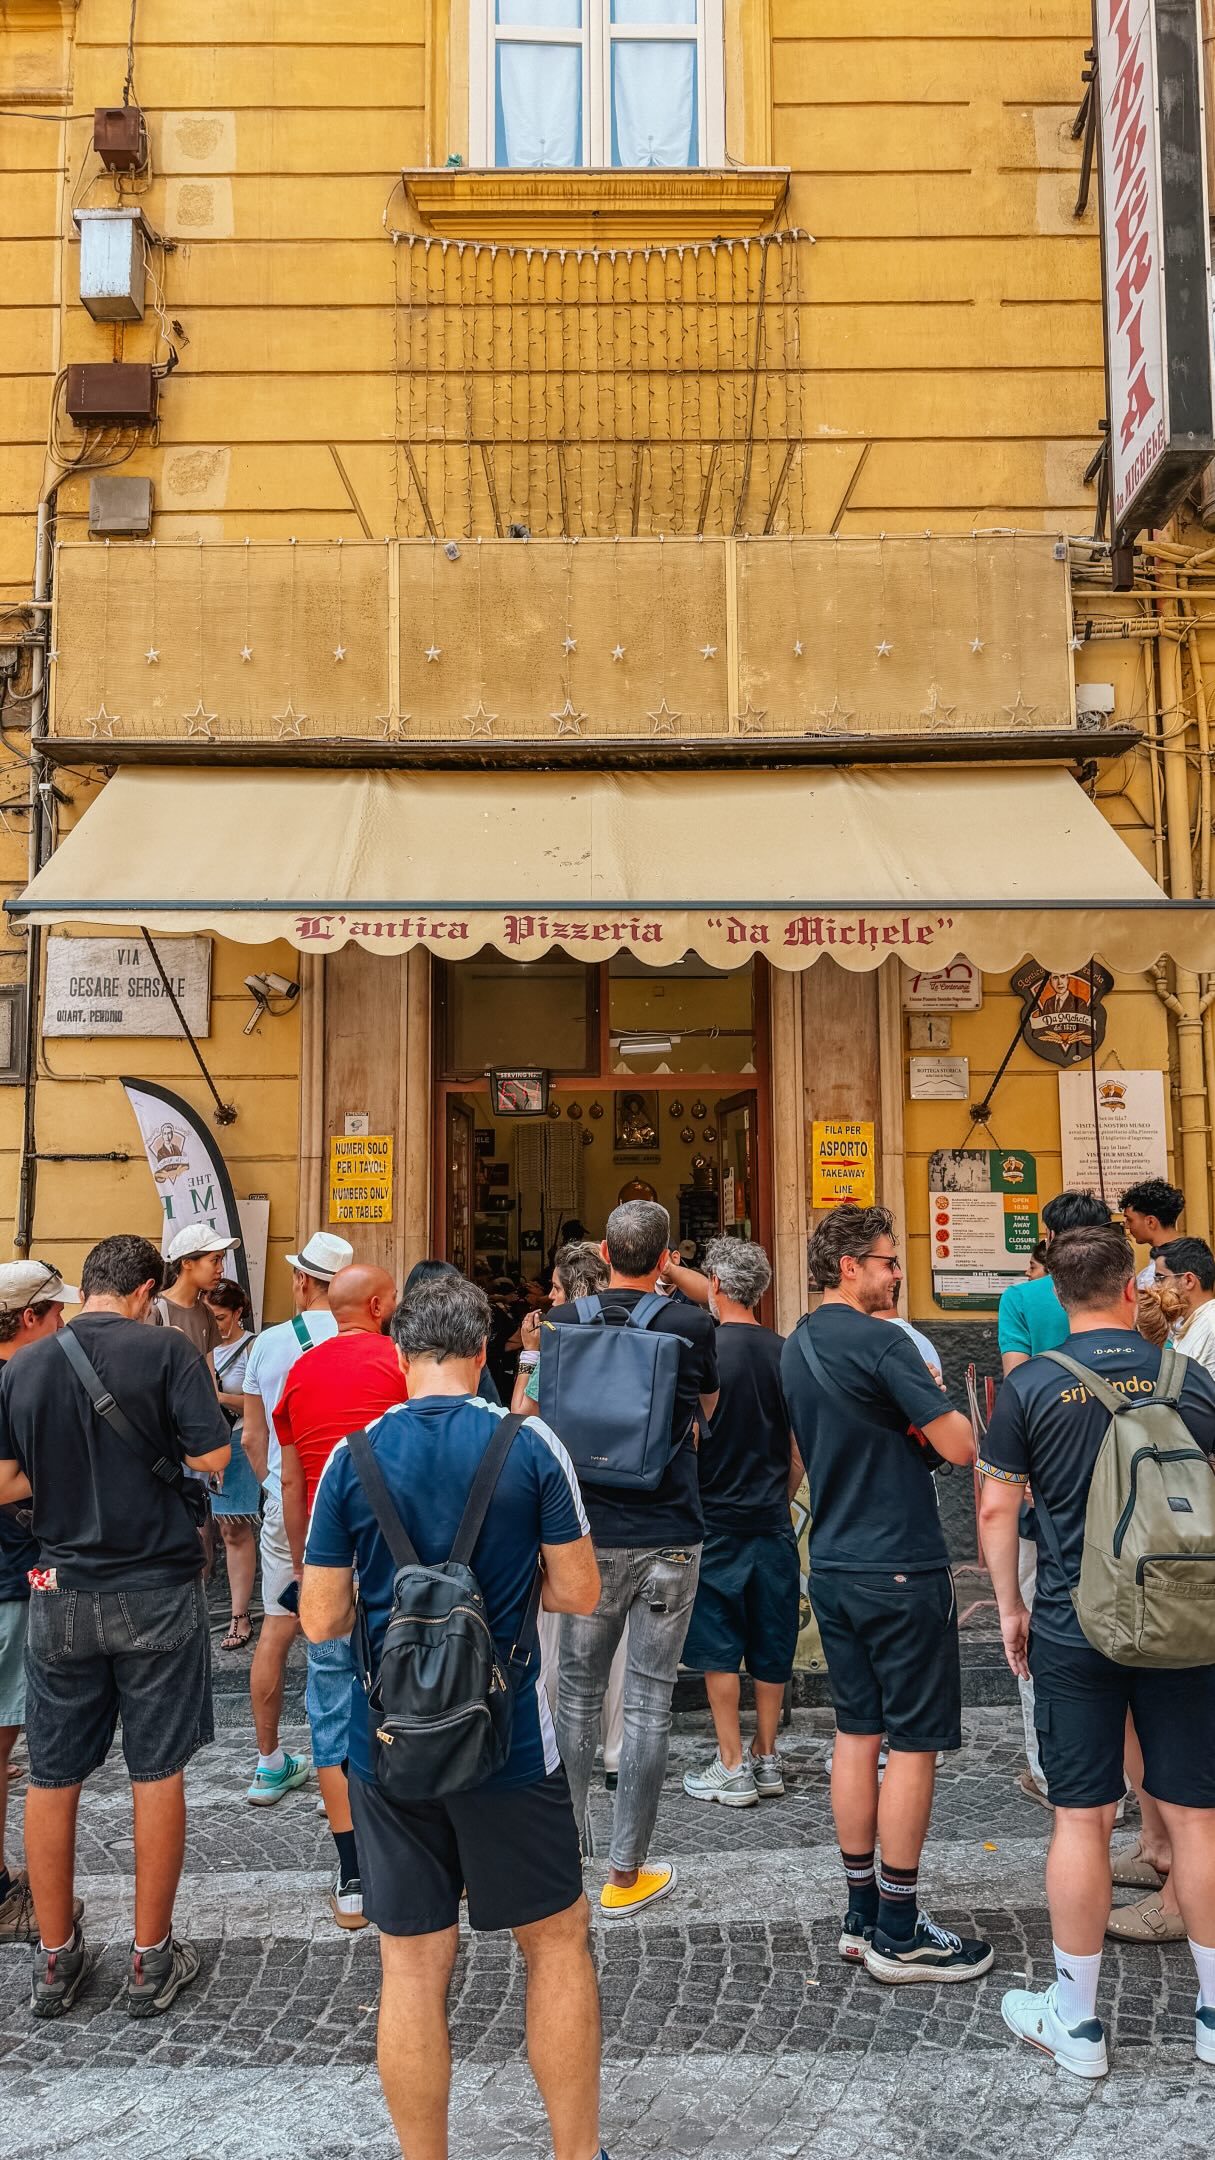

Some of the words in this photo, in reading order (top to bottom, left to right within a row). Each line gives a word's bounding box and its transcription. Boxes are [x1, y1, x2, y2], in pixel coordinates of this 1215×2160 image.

[295, 914, 470, 940] L'antica
[503, 914, 664, 945] Pizzeria
[118, 949, 140, 966] VIA
[69, 976, 119, 997] CESARE
[127, 977, 186, 998] SERSALE
[56, 1009, 87, 1023] QUART.
[89, 1009, 123, 1023] PENDINO
[1042, 1015, 1057, 1025] Da
[1057, 1013, 1089, 1024] Michele
[928, 1022, 933, 1042] 1
[1063, 1023, 1077, 1031] 1870
[825, 1126, 842, 1135] FILA
[845, 1126, 861, 1135] PER
[335, 1142, 365, 1155] NUMERI
[367, 1142, 388, 1154] SOLO
[819, 1141, 868, 1156] ASPORTO
[336, 1161, 352, 1173] PER
[354, 1161, 357, 1173] I
[821, 1169, 866, 1178] TAKEAWAY
[332, 1187, 368, 1200] NUMBERS
[370, 1187, 389, 1199] ONLY
[834, 1185, 853, 1194] LINE
[338, 1206, 354, 1218] FOR
[355, 1206, 383, 1218] TABLES
